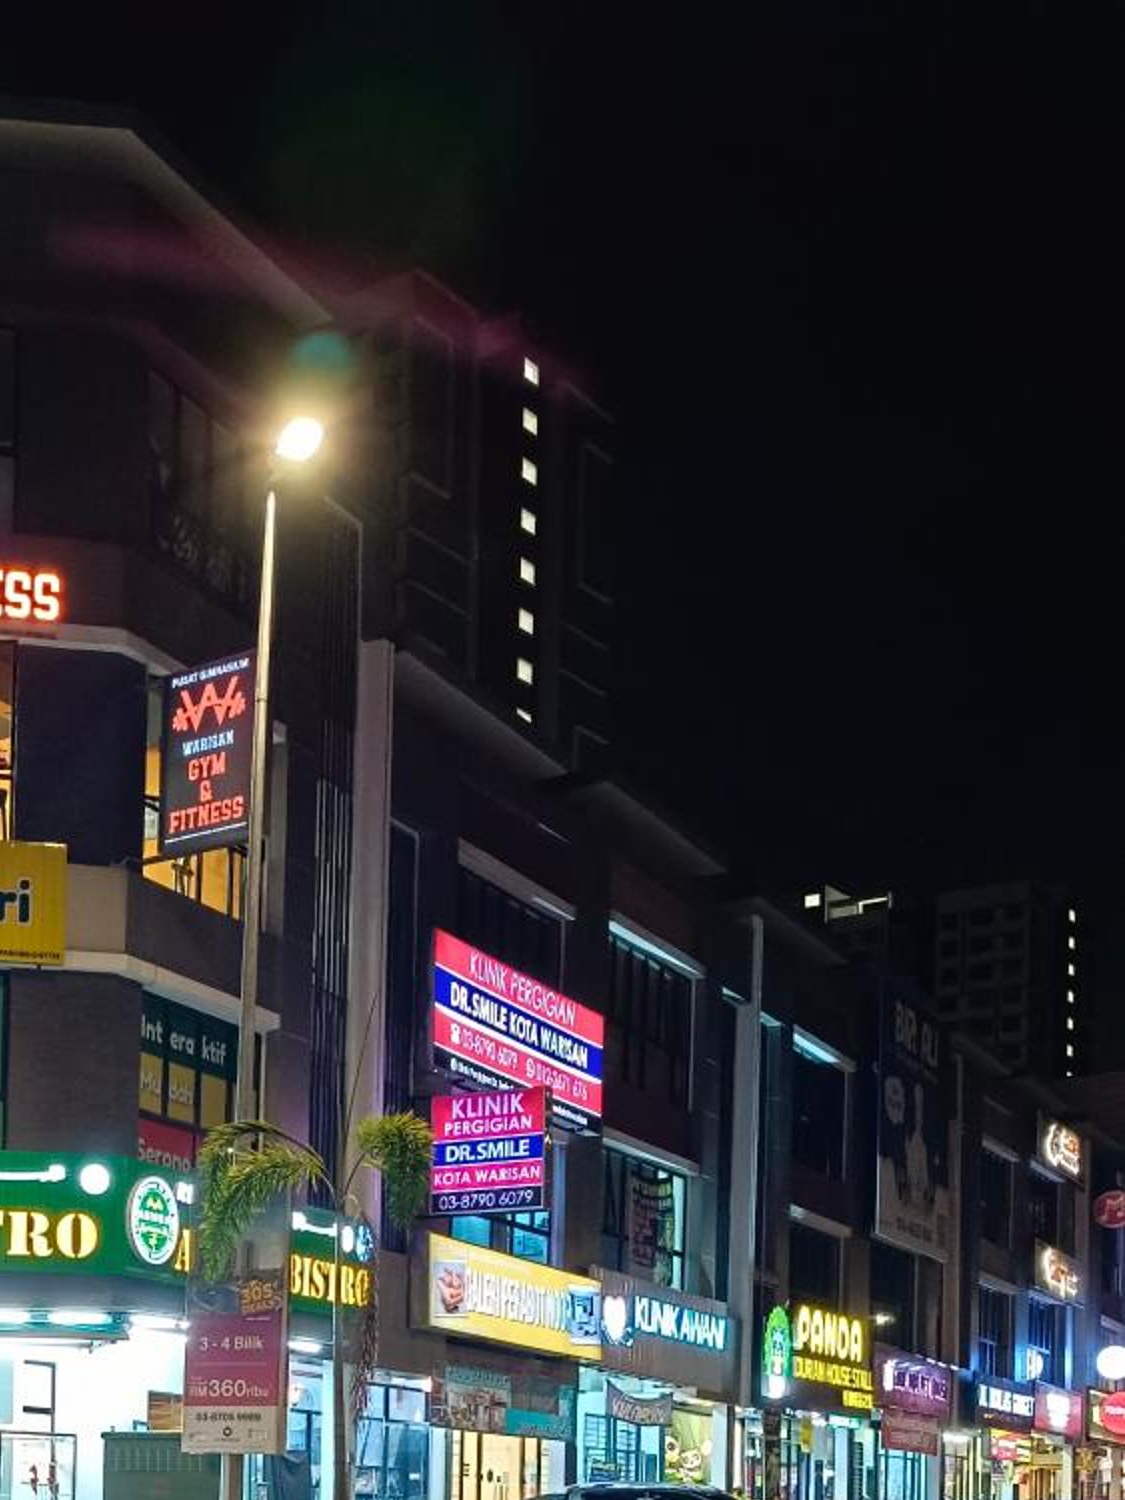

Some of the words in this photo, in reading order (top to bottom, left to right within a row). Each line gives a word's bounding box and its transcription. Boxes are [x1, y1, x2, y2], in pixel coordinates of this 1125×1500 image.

[183, 729, 234, 756] WARISAN
[188, 752, 226, 781] GYM
[200, 780, 213, 801] &
[169, 796, 244, 834] FITNESS
[470, 951, 507, 991] KLINIK
[511, 969, 577, 1026] PERGIGIAN
[510, 1008, 539, 1045] KOTA
[540, 1021, 588, 1069] WARISAN
[451, 1093, 524, 1119] KLINIK
[444, 1114, 533, 1137] PERGIGIAN
[434, 1171, 471, 1186] KOTA
[475, 1165, 541, 1183] WARISAN
[438, 1193, 497, 1210] 03-8790
[498, 1190, 534, 1206] 6079
[290, 1253, 370, 1307] BISTRO
[794, 1304, 864, 1363] PANDA
